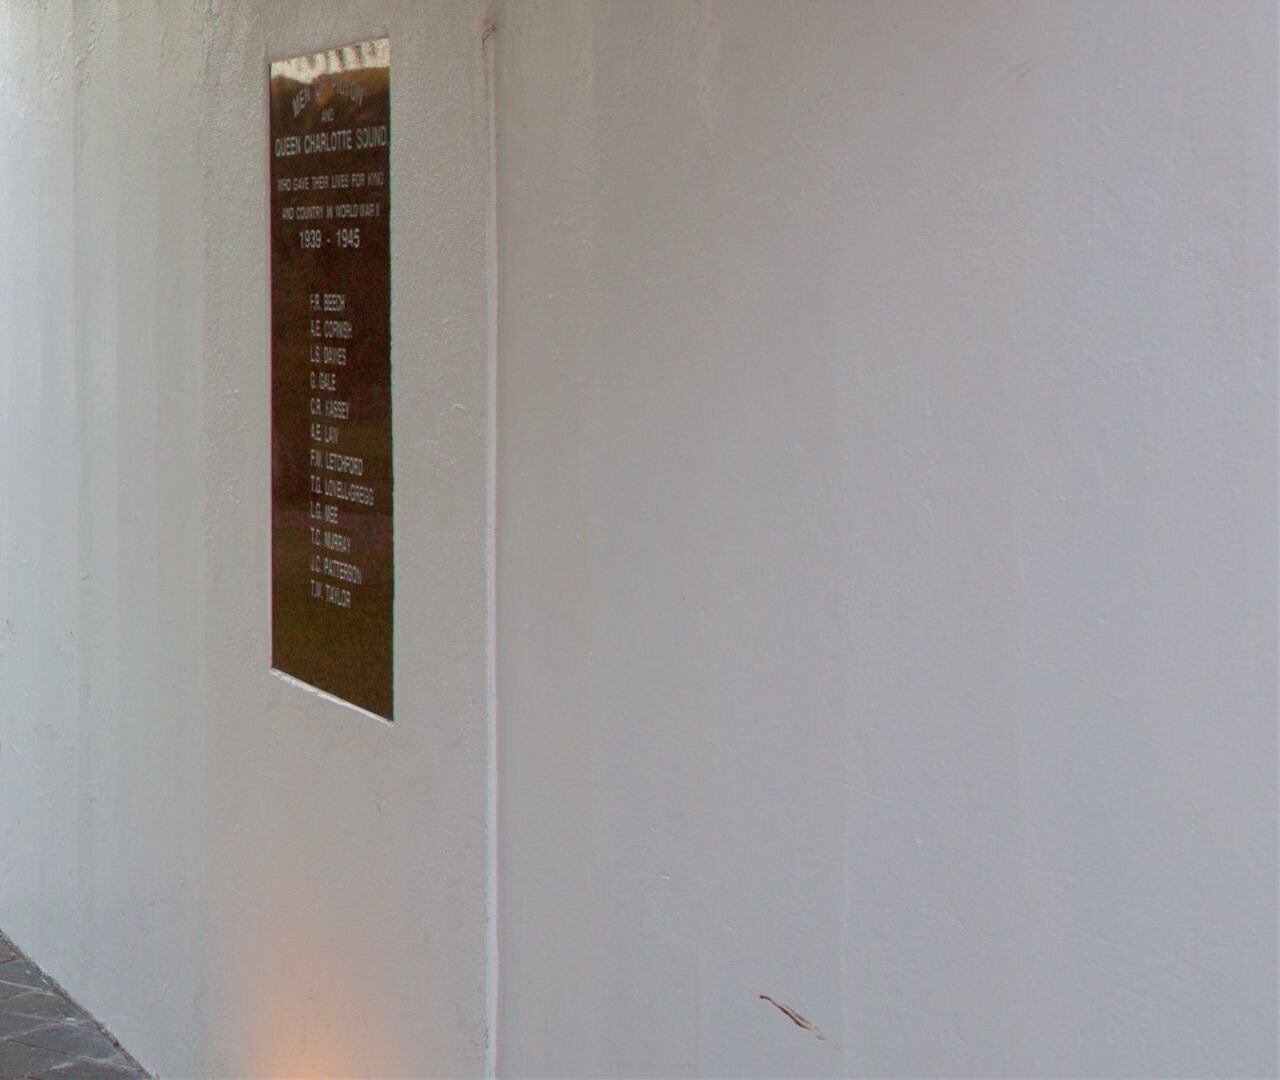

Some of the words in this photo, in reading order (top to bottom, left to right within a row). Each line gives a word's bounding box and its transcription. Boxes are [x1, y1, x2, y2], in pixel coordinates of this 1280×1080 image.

[292, 84, 311, 117] MEN
[321, 108, 334, 123] AND
[275, 136, 301, 157] QUEEN
[303, 129, 352, 155] CHARLOTTE
[277, 178, 291, 192] WHO
[293, 177, 310, 191] GAVE
[311, 175, 329, 190] THEIR
[331, 174, 349, 189] LIVES
[351, 172, 365, 187] FOR
[367, 171, 385, 187] KING
[282, 206, 295, 220] AND
[296, 205, 324, 220] COUNTRY
[335, 203, 357, 218] WORLD
[359, 203, 374, 217] WAR
[299, 228, 322, 249] 1939
[336, 227, 360, 249] 1945
[323, 557, 362, 585] PATTERSON
[325, 584, 351, 609] TAYLOR
